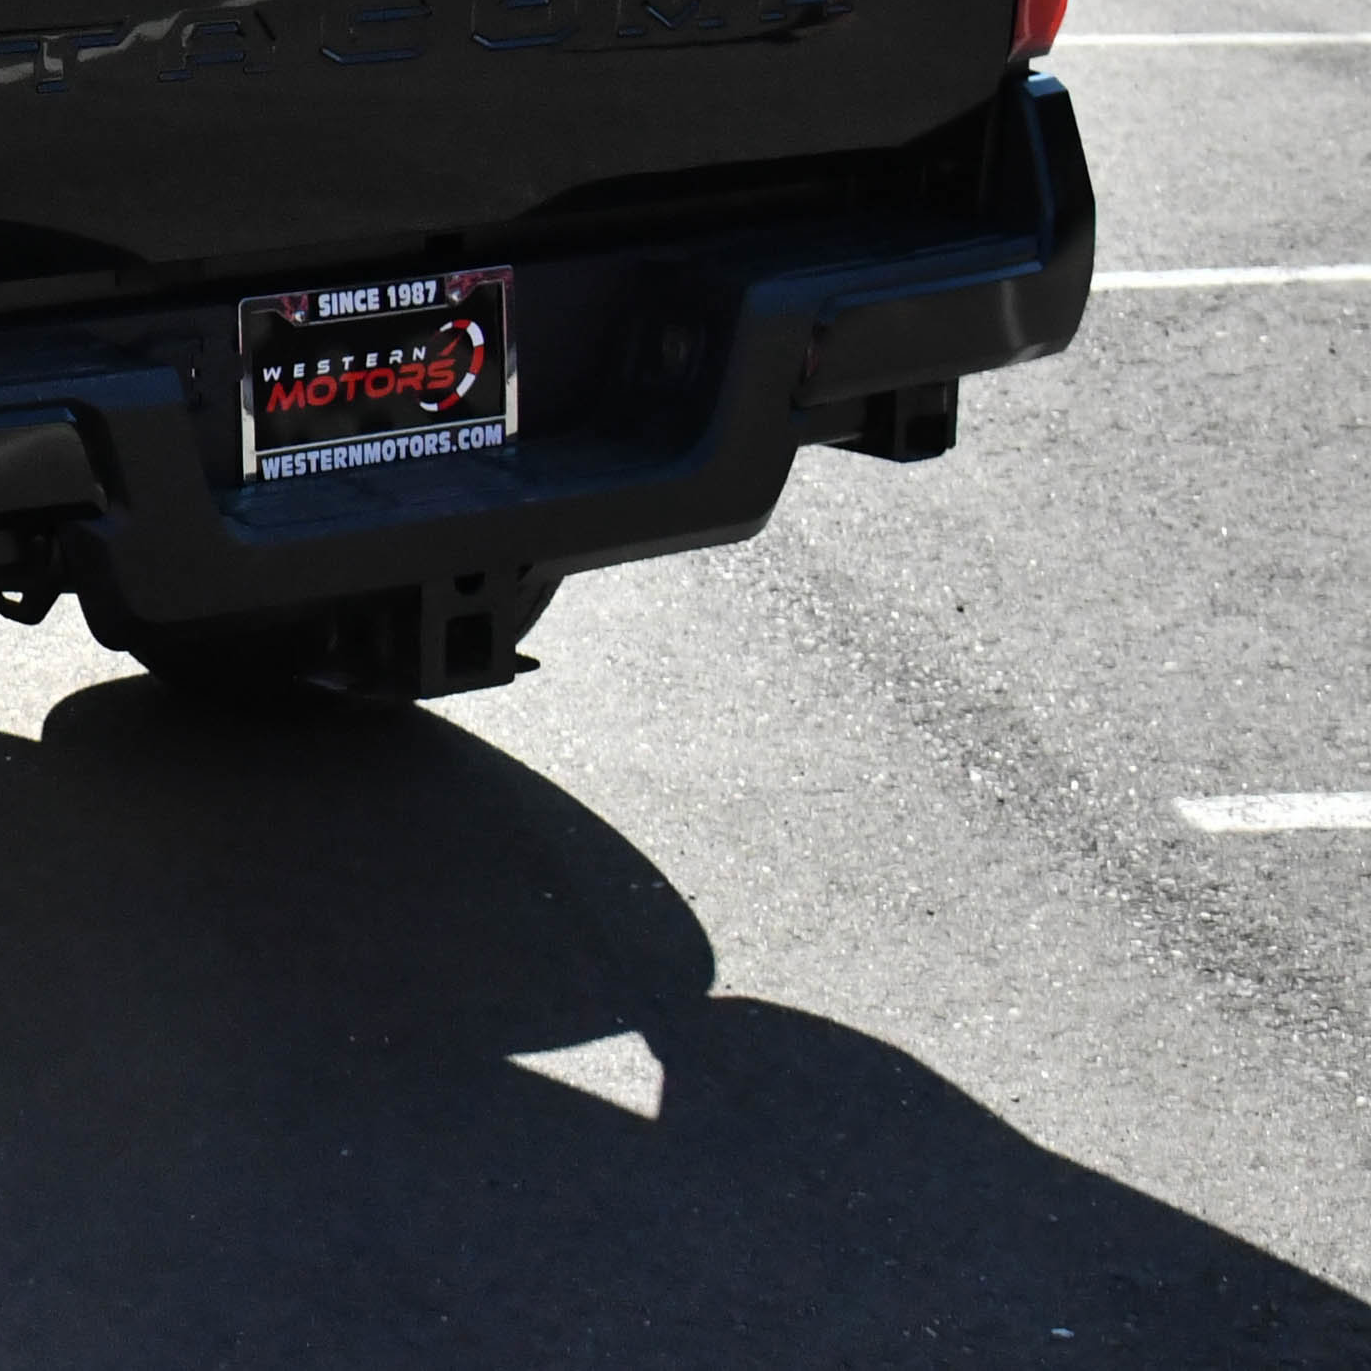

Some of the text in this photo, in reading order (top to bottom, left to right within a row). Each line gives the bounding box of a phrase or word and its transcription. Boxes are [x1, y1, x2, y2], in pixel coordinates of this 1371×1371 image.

[318, 280, 438, 318] SINCE 1987
[262, 346, 427, 382] WESTERN
[265, 358, 456, 412] MOTORS
[261, 423, 504, 481] WESTERNMOTORS.COM
